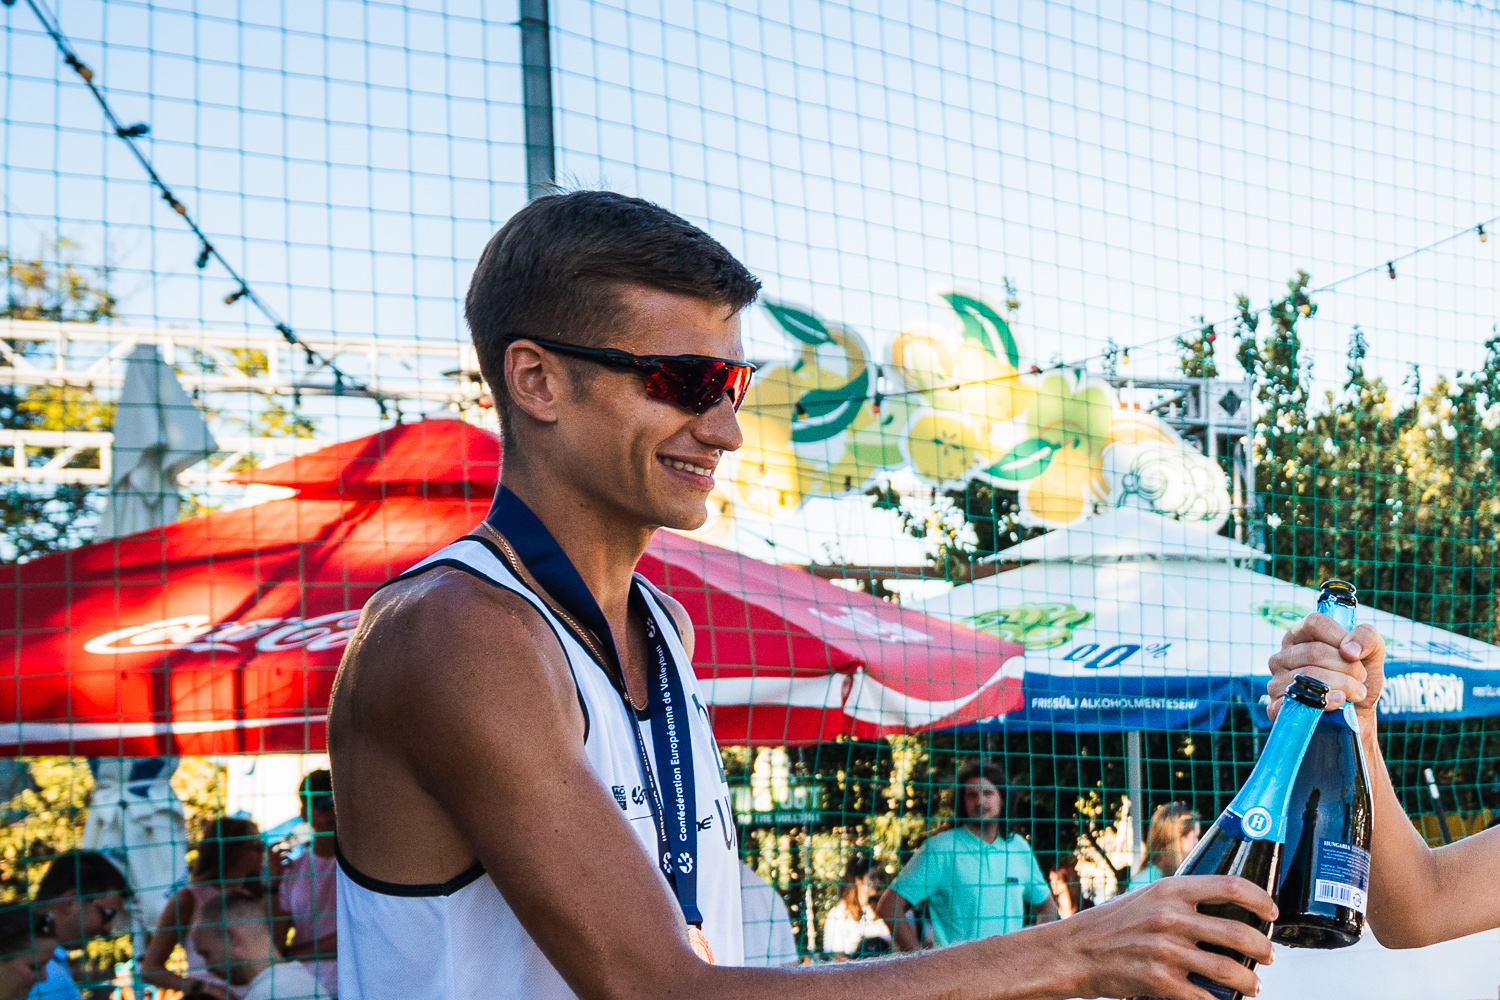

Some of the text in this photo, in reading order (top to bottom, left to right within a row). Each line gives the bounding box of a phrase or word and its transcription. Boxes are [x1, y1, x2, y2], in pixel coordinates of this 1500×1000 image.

[655, 644, 687, 841] Confédération Européenne de Volleyball
[1250, 815, 1265, 830] H
[1323, 840, 1351, 850] HUNGARIA
